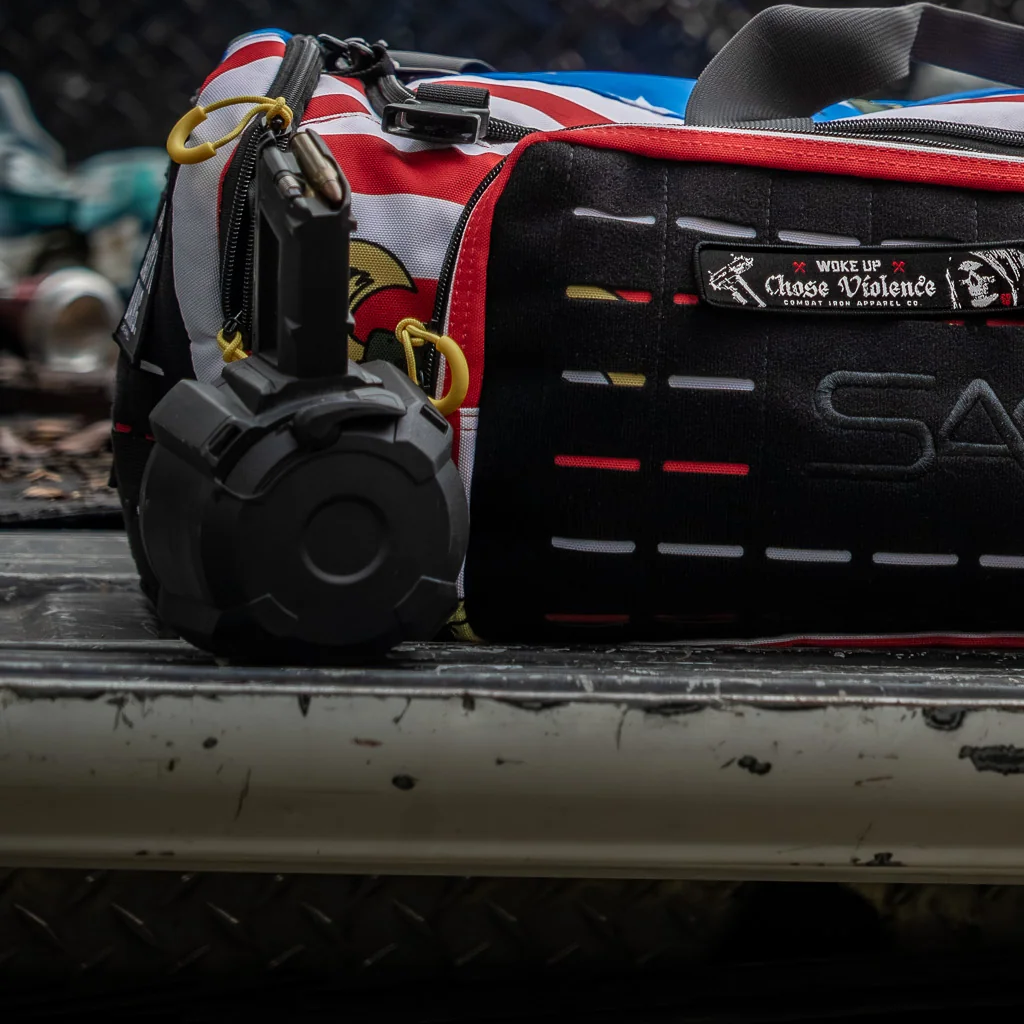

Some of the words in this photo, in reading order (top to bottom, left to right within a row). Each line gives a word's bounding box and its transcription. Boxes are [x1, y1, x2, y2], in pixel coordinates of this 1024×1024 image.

[816, 260, 858, 272] WOKE
[862, 260, 881, 272] UP
[765, 274, 830, 298] Chose
[838, 275, 936, 298] Violence
